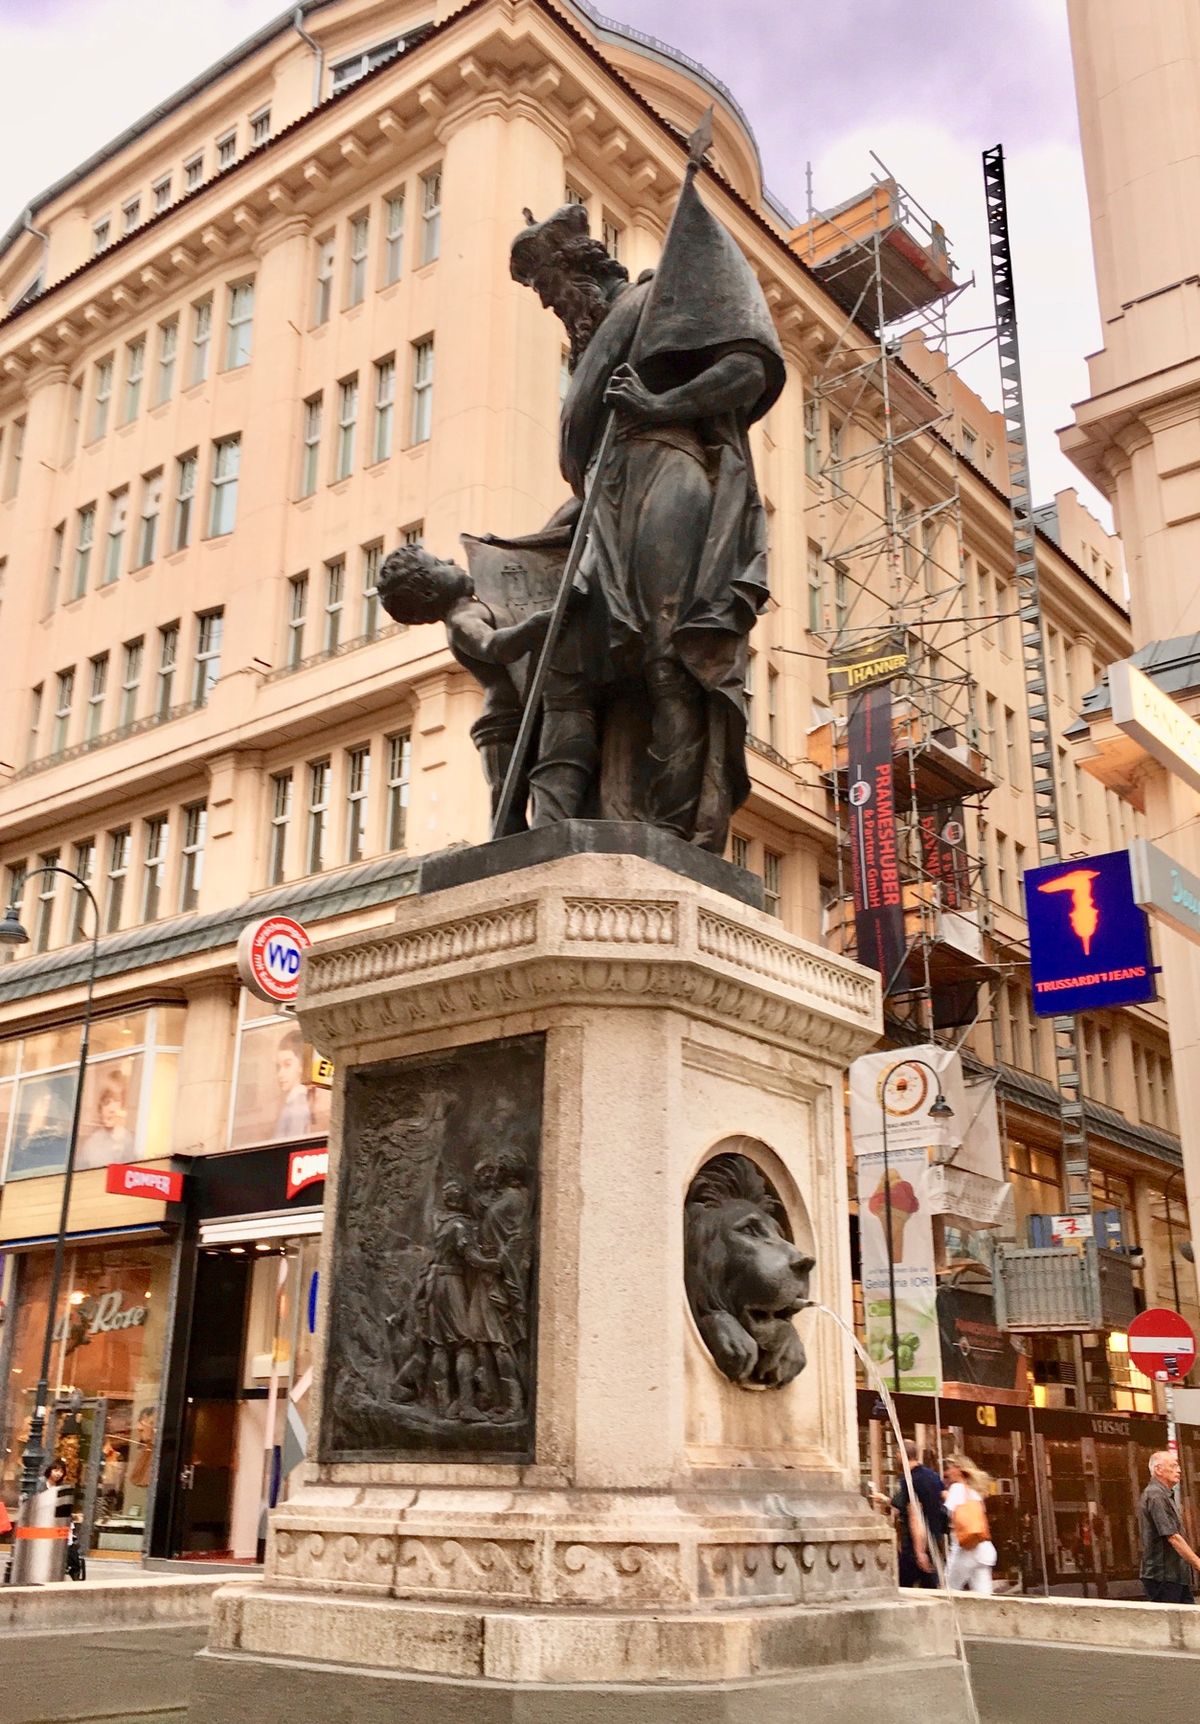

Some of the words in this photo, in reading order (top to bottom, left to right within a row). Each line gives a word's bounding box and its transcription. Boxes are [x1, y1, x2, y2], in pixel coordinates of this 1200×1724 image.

[846, 655, 908, 687] THANNER
[864, 821, 876, 865] Partner
[875, 763, 901, 905] PRAMESHUBER
[867, 868, 881, 908] GmbH
[1035, 977, 1100, 993] TRUSSARDI
[1108, 966, 1147, 982] JEANS
[1091, 1418, 1131, 1437] VERSACE
